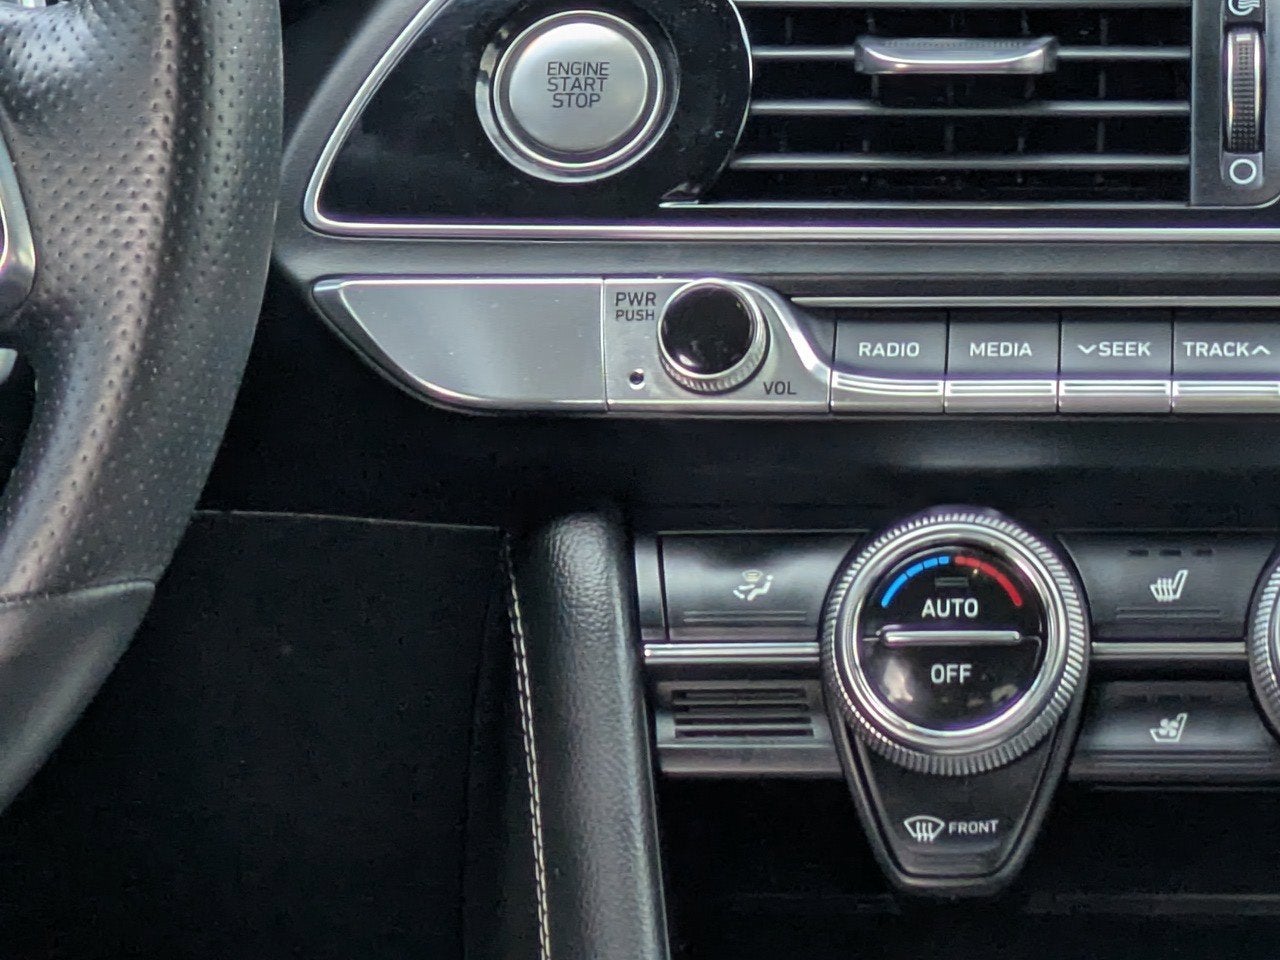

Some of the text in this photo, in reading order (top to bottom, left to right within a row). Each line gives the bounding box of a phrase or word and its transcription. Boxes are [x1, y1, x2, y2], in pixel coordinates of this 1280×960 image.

[547, 61, 610, 76] ENGINE
[546, 77, 608, 92] START
[552, 93, 601, 108] STOP
[616, 292, 657, 308] PWR
[615, 309, 655, 322] PUSH
[858, 342, 920, 358] RADIO
[969, 342, 1033, 358] MEDIA
[1099, 341, 1151, 357] SEEK
[1182, 341, 1250, 357] TRACK
[763, 381, 797, 396] VOL
[922, 598, 979, 618] AUTO
[930, 664, 973, 684] OFF
[949, 819, 999, 834] FRONT
